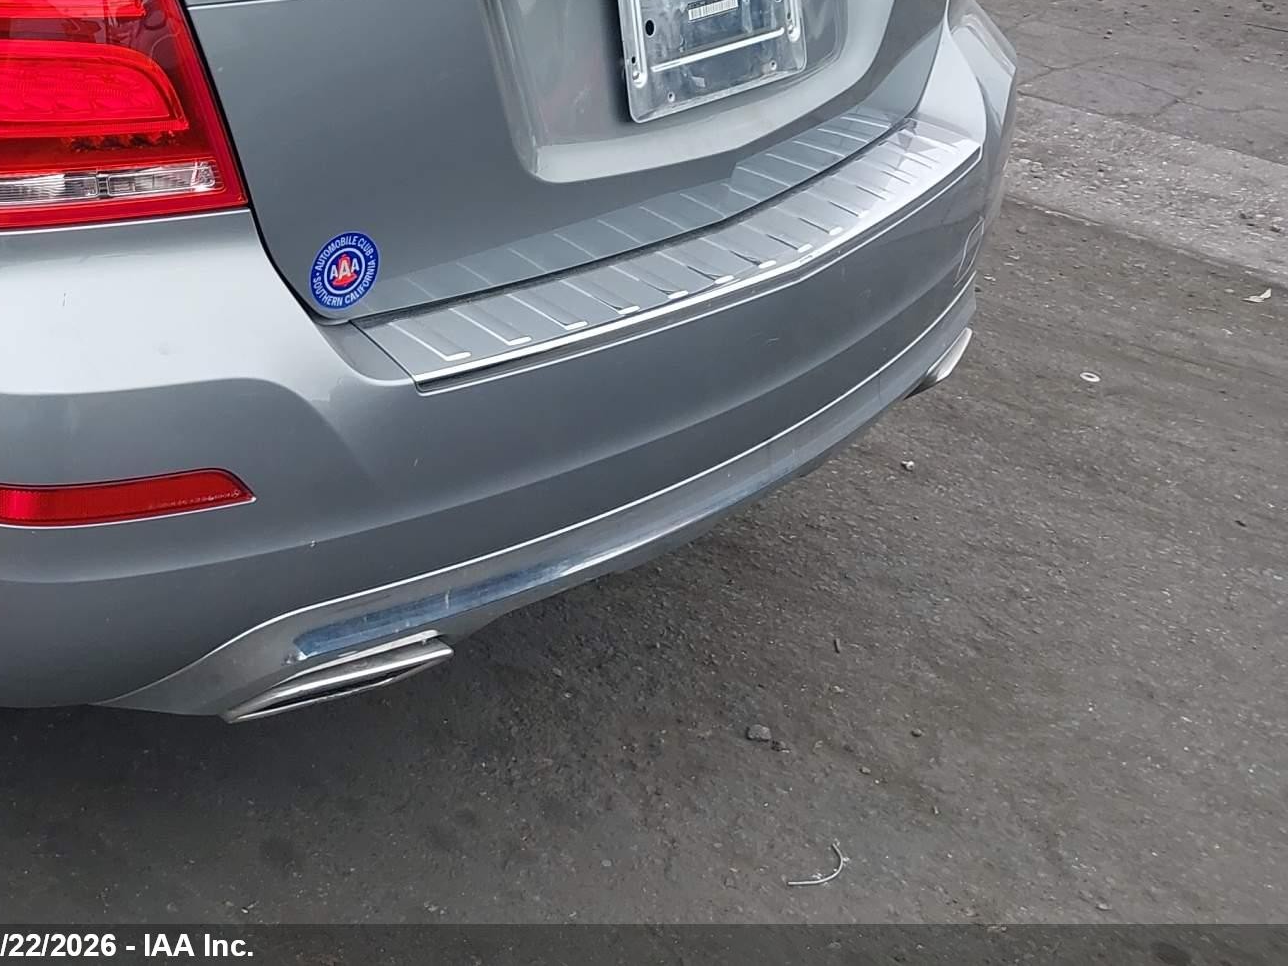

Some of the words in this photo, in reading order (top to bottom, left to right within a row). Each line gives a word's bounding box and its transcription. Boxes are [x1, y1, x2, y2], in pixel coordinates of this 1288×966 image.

[315, 235, 358, 271] AUTOMOBILE
[357, 237, 374, 257] CLUB
[329, 257, 360, 281] AAA
[313, 276, 343, 307] SOUTHERN
[344, 259, 376, 304] CALIFORNIA
